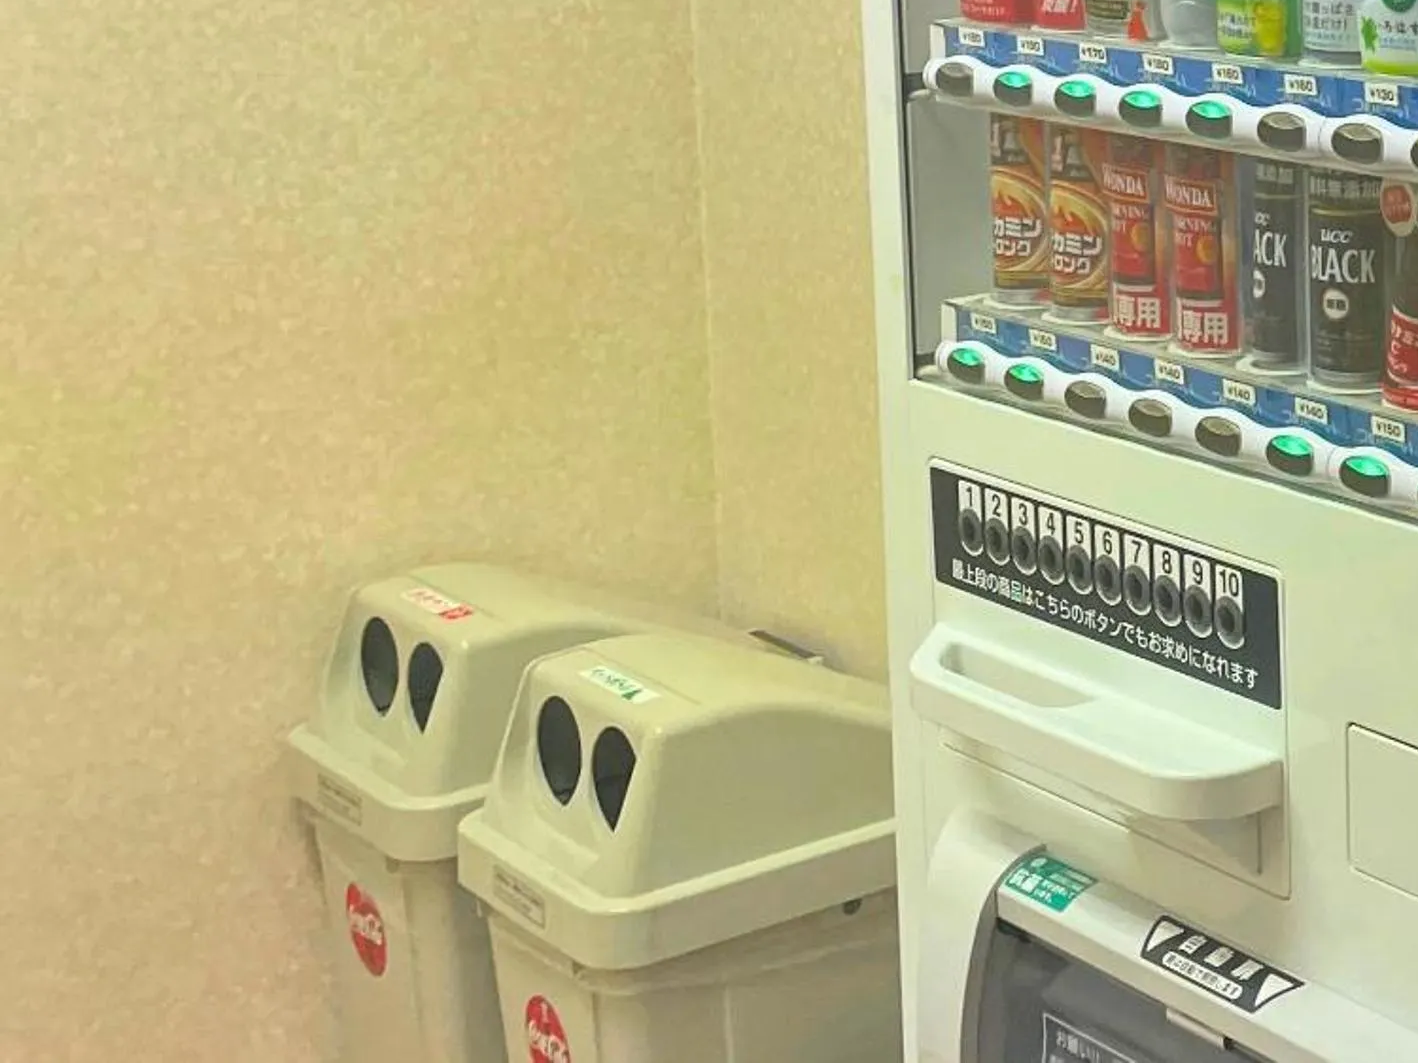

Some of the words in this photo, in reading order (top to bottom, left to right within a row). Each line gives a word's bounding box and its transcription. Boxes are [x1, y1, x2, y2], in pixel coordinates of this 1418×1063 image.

[1103, 165, 1145, 196] WONDA
[1165, 176, 1212, 208] WONDA
[1311, 244, 1376, 284] BLACK
[965, 486, 975, 508] 1
[991, 494, 1002, 517] 2
[1018, 503, 1029, 526] 3
[1046, 512, 1057, 536] 4
[1073, 521, 1085, 545] 5
[1103, 530, 1113, 554] 6
[1131, 540, 1142, 564] 7
[1161, 551, 1173, 574] 8
[1192, 561, 1204, 586] 9
[1219, 568, 1240, 597] 10
